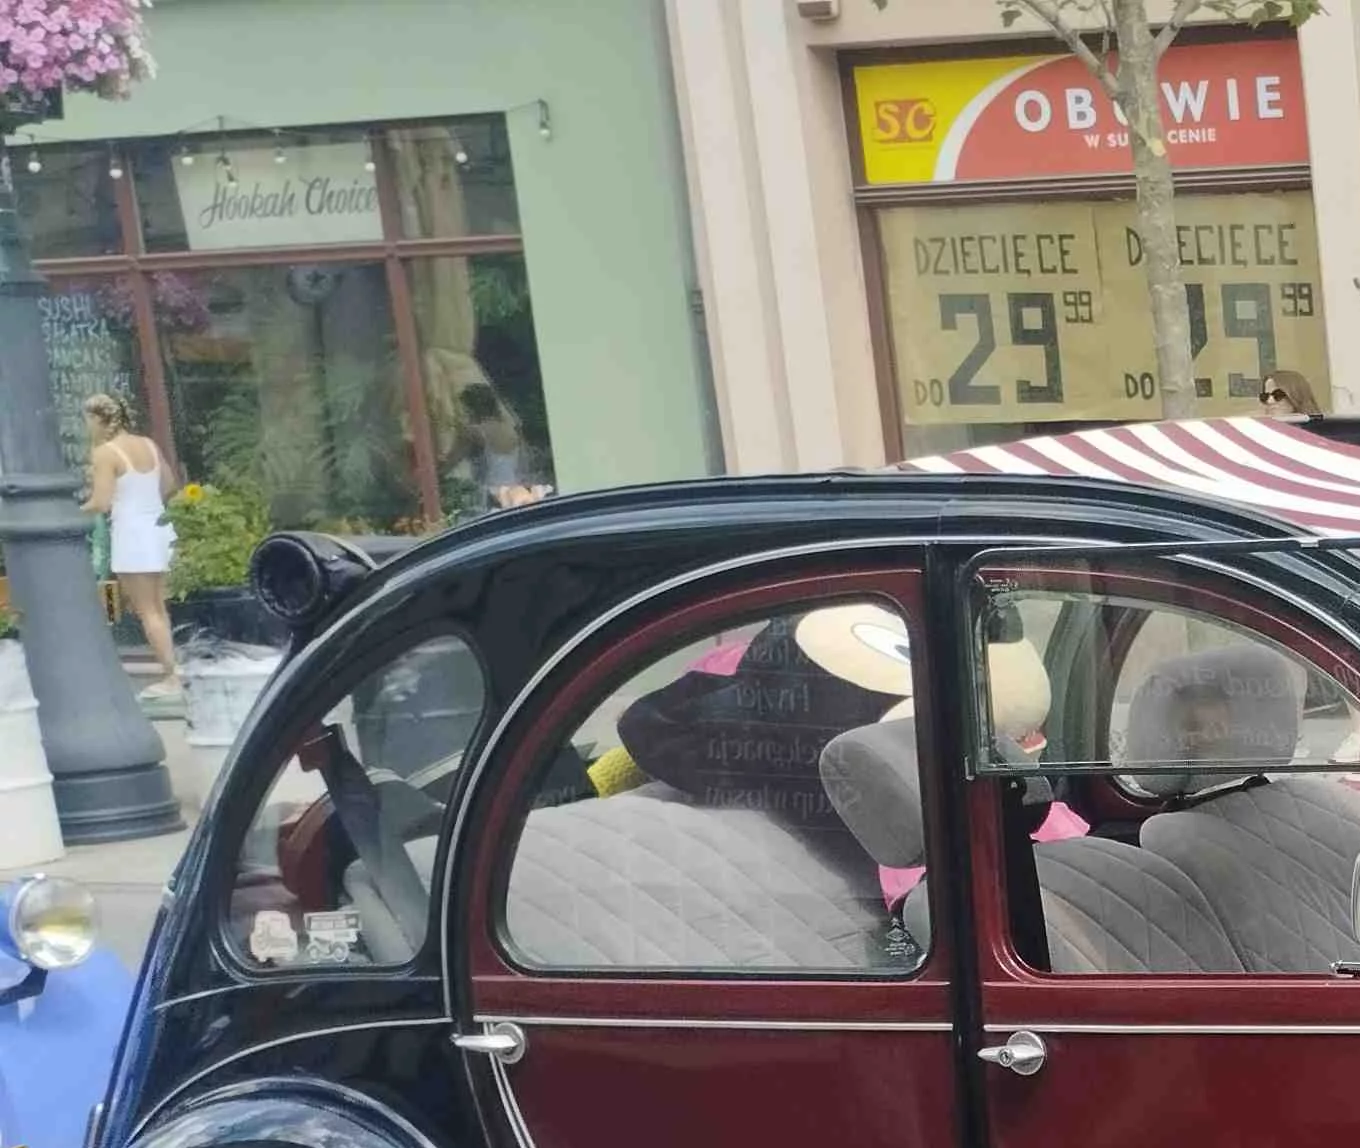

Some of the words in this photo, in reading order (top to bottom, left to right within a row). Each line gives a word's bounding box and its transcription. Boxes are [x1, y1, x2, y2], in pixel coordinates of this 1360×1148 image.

[873, 100, 937, 143] SC
[1014, 76, 1284, 132] OBWIE
[1084, 134, 1101, 148] W
[1166, 128, 1216, 144] CENIE
[200, 180, 296, 229] Hookah
[305, 176, 378, 216] Choice
[914, 233, 1078, 278] DZIECIĘCE
[1126, 223, 1298, 267] DECIĘCE
[914, 379, 944, 407] DO
[938, 292, 1064, 405] 29
[1062, 290, 1094, 324] 99
[1124, 372, 1155, 400] DO
